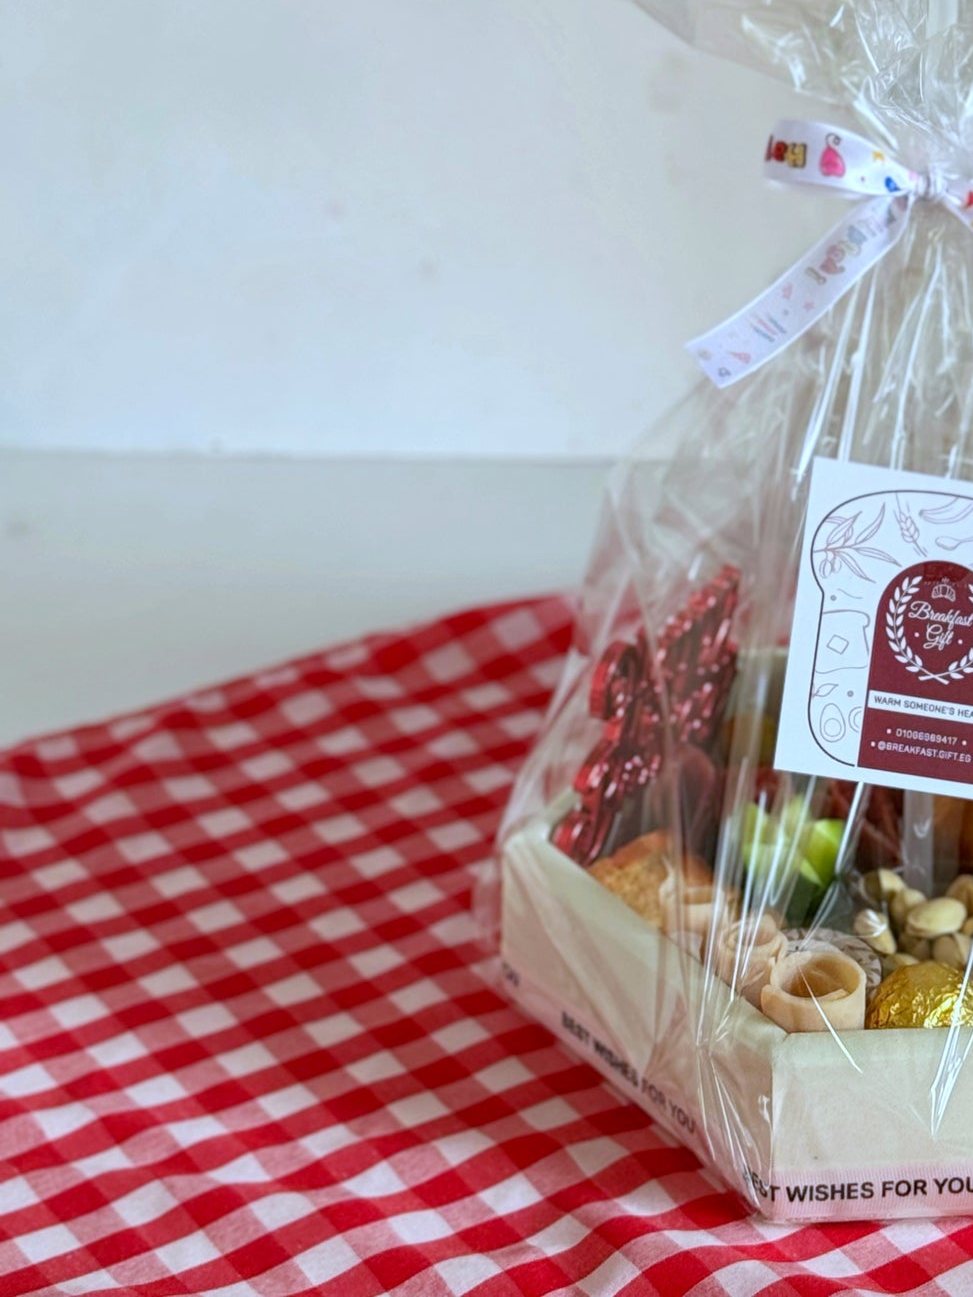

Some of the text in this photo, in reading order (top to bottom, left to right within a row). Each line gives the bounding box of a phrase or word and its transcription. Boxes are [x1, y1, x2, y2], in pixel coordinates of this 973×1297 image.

[923, 623, 955, 651] Gift
[874, 695, 901, 706] WARM
[904, 700, 955, 715] SOMEONE'S
[669, 1100, 695, 1134] YOU
[786, 1182, 874, 1202] WISHES
[881, 1179, 928, 1198] FOR
